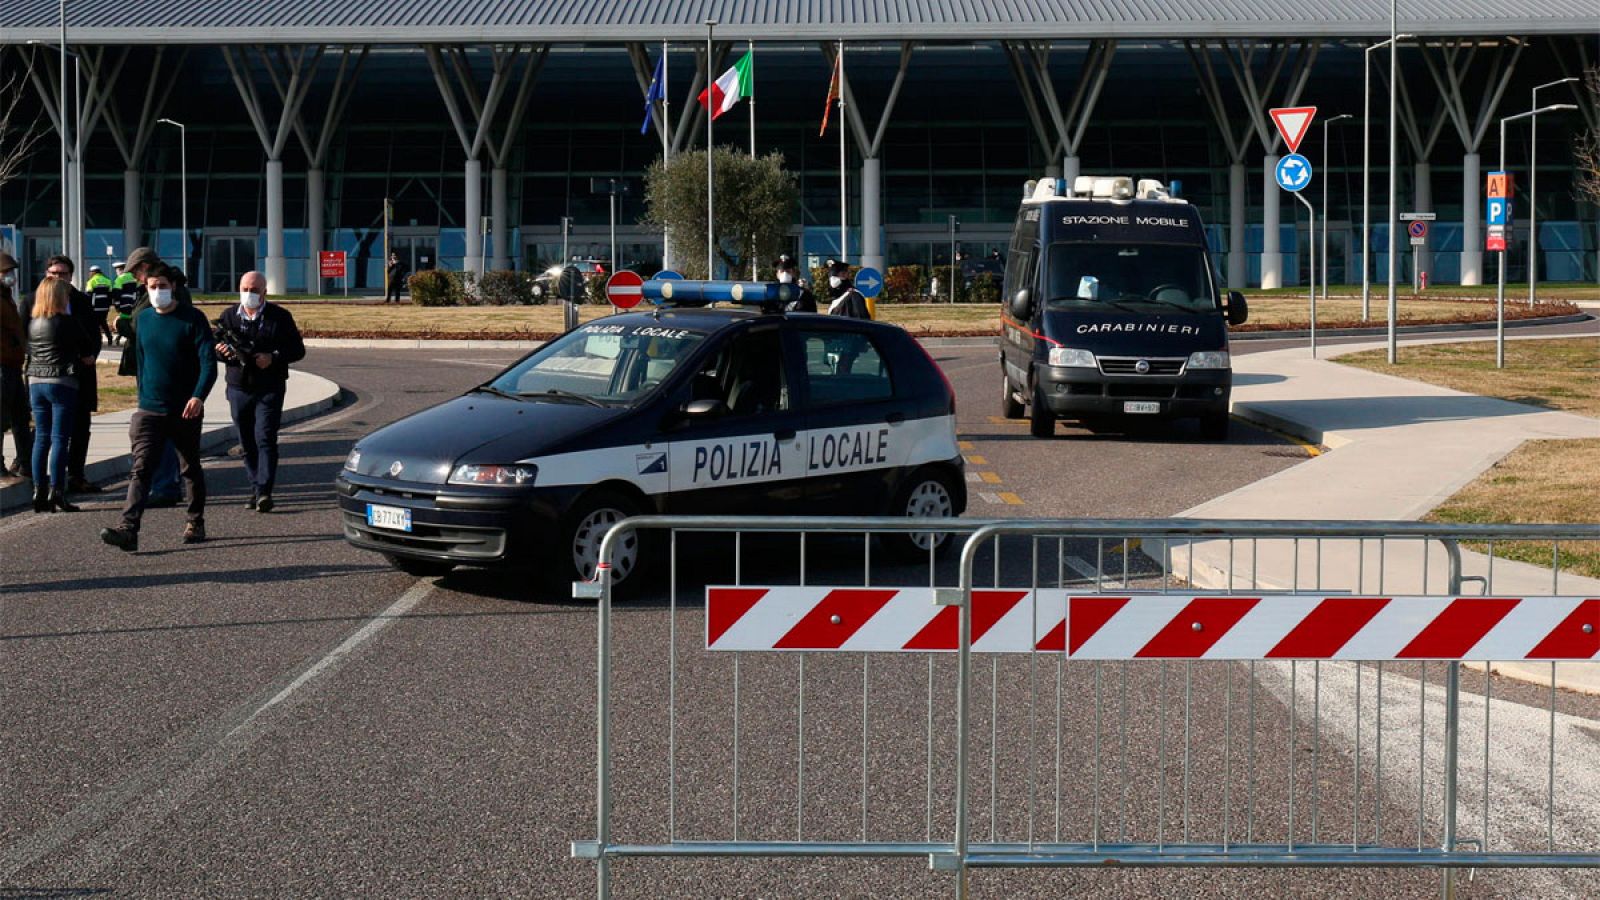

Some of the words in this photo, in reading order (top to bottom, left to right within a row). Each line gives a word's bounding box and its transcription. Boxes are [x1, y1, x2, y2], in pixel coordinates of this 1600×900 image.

[1490, 202, 1502, 222] P
[1063, 216, 1129, 225] STAZIONE
[1136, 217, 1189, 228] MOBILE
[631, 326, 690, 340] LOCALE
[1077, 323, 1200, 335] CARABINIERI
[693, 440, 782, 482] POLIZIA
[809, 429, 888, 470] LOCALE
